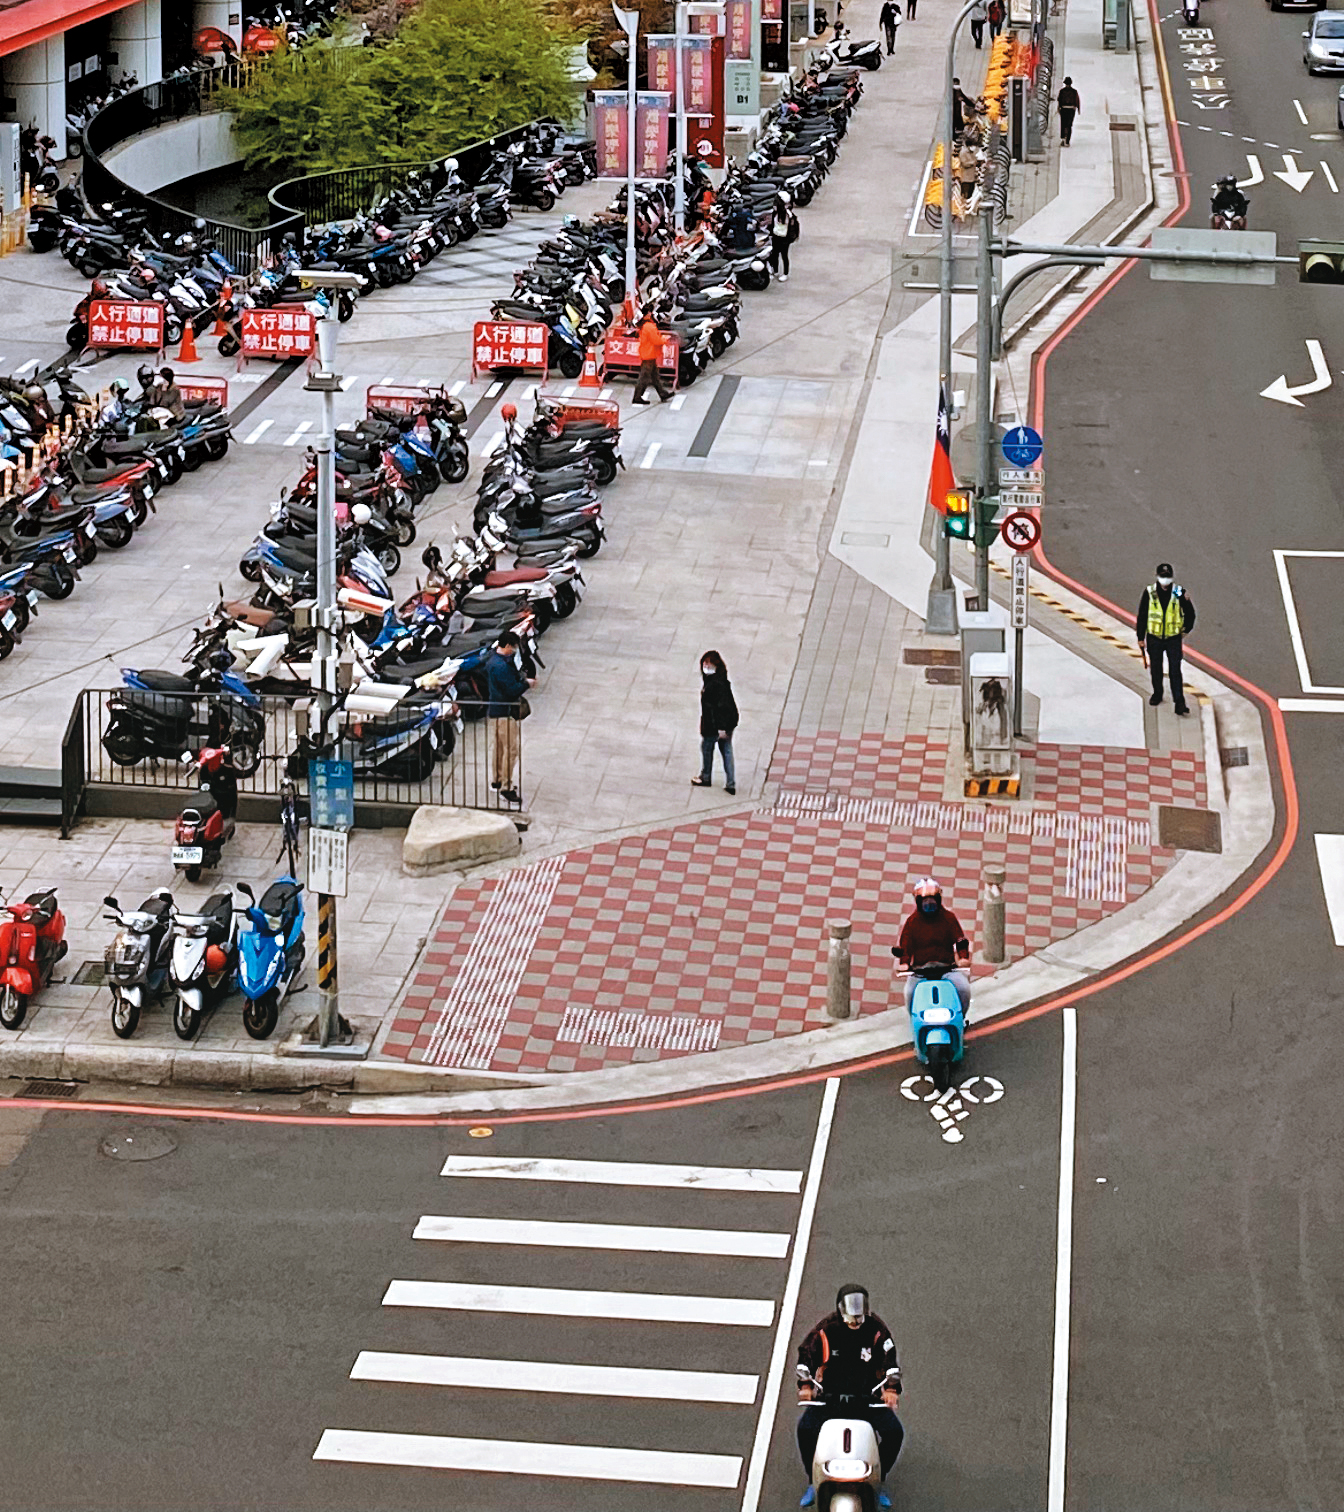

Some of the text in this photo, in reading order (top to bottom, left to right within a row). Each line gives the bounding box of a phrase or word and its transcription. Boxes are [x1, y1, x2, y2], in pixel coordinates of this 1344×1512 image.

[737, 94, 750, 105] B1
[92, 304, 160, 324] 人行通道
[244, 311, 311, 332] 人行通道
[91, 325, 160, 345] 禁止停車
[244, 332, 311, 352] 禁止停車
[475, 325, 544, 344] 人行通道
[475, 345, 544, 366] 禁止停車
